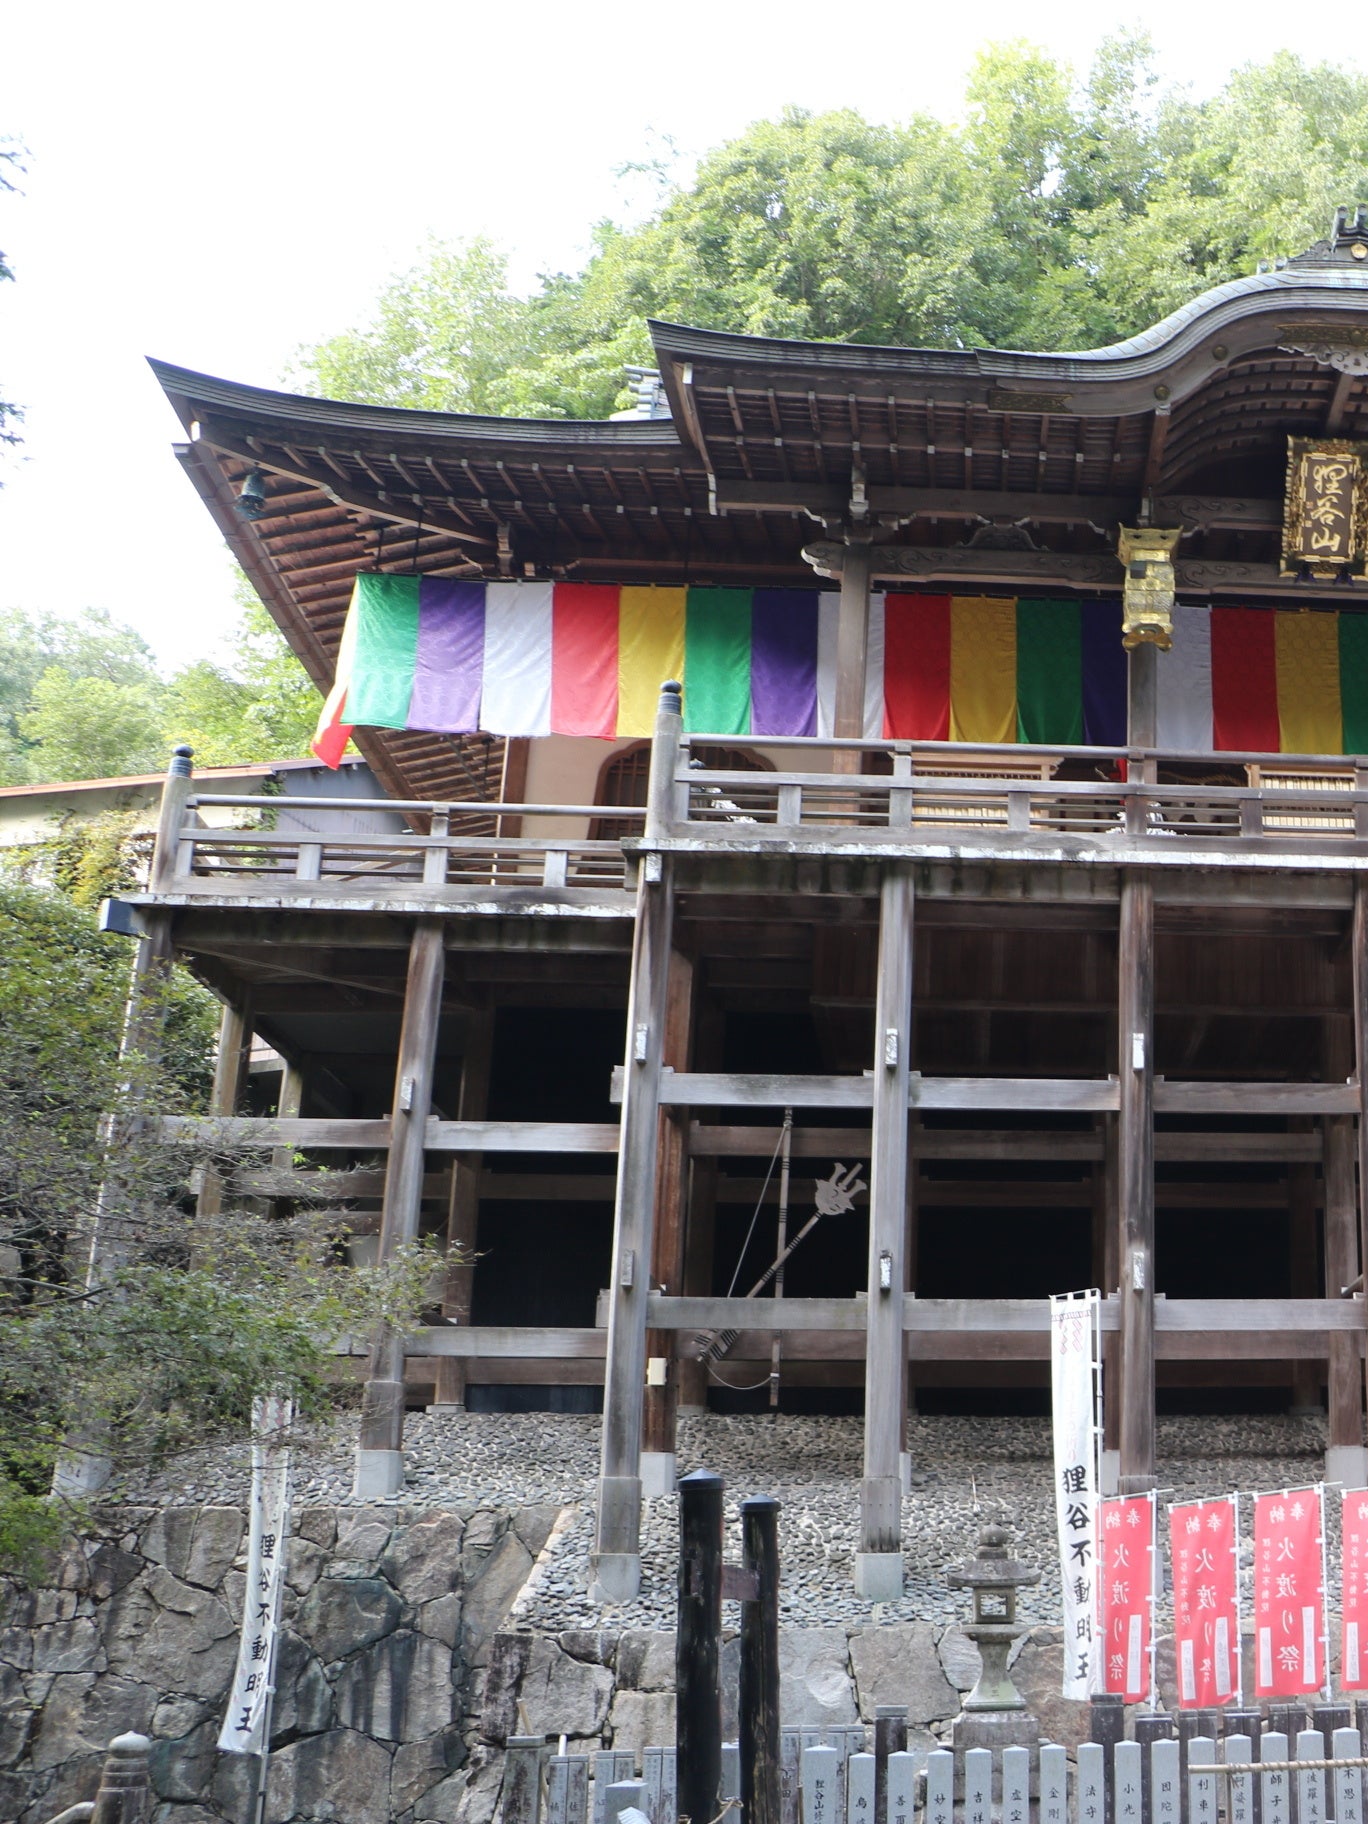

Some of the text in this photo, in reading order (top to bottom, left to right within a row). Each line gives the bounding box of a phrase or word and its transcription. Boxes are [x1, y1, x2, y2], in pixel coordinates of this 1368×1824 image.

[234, 1534, 276, 1733] 狸谷不動明王
[1049, 1787, 1060, 1820] 金剛
[1124, 1783, 1135, 1816] 小光
